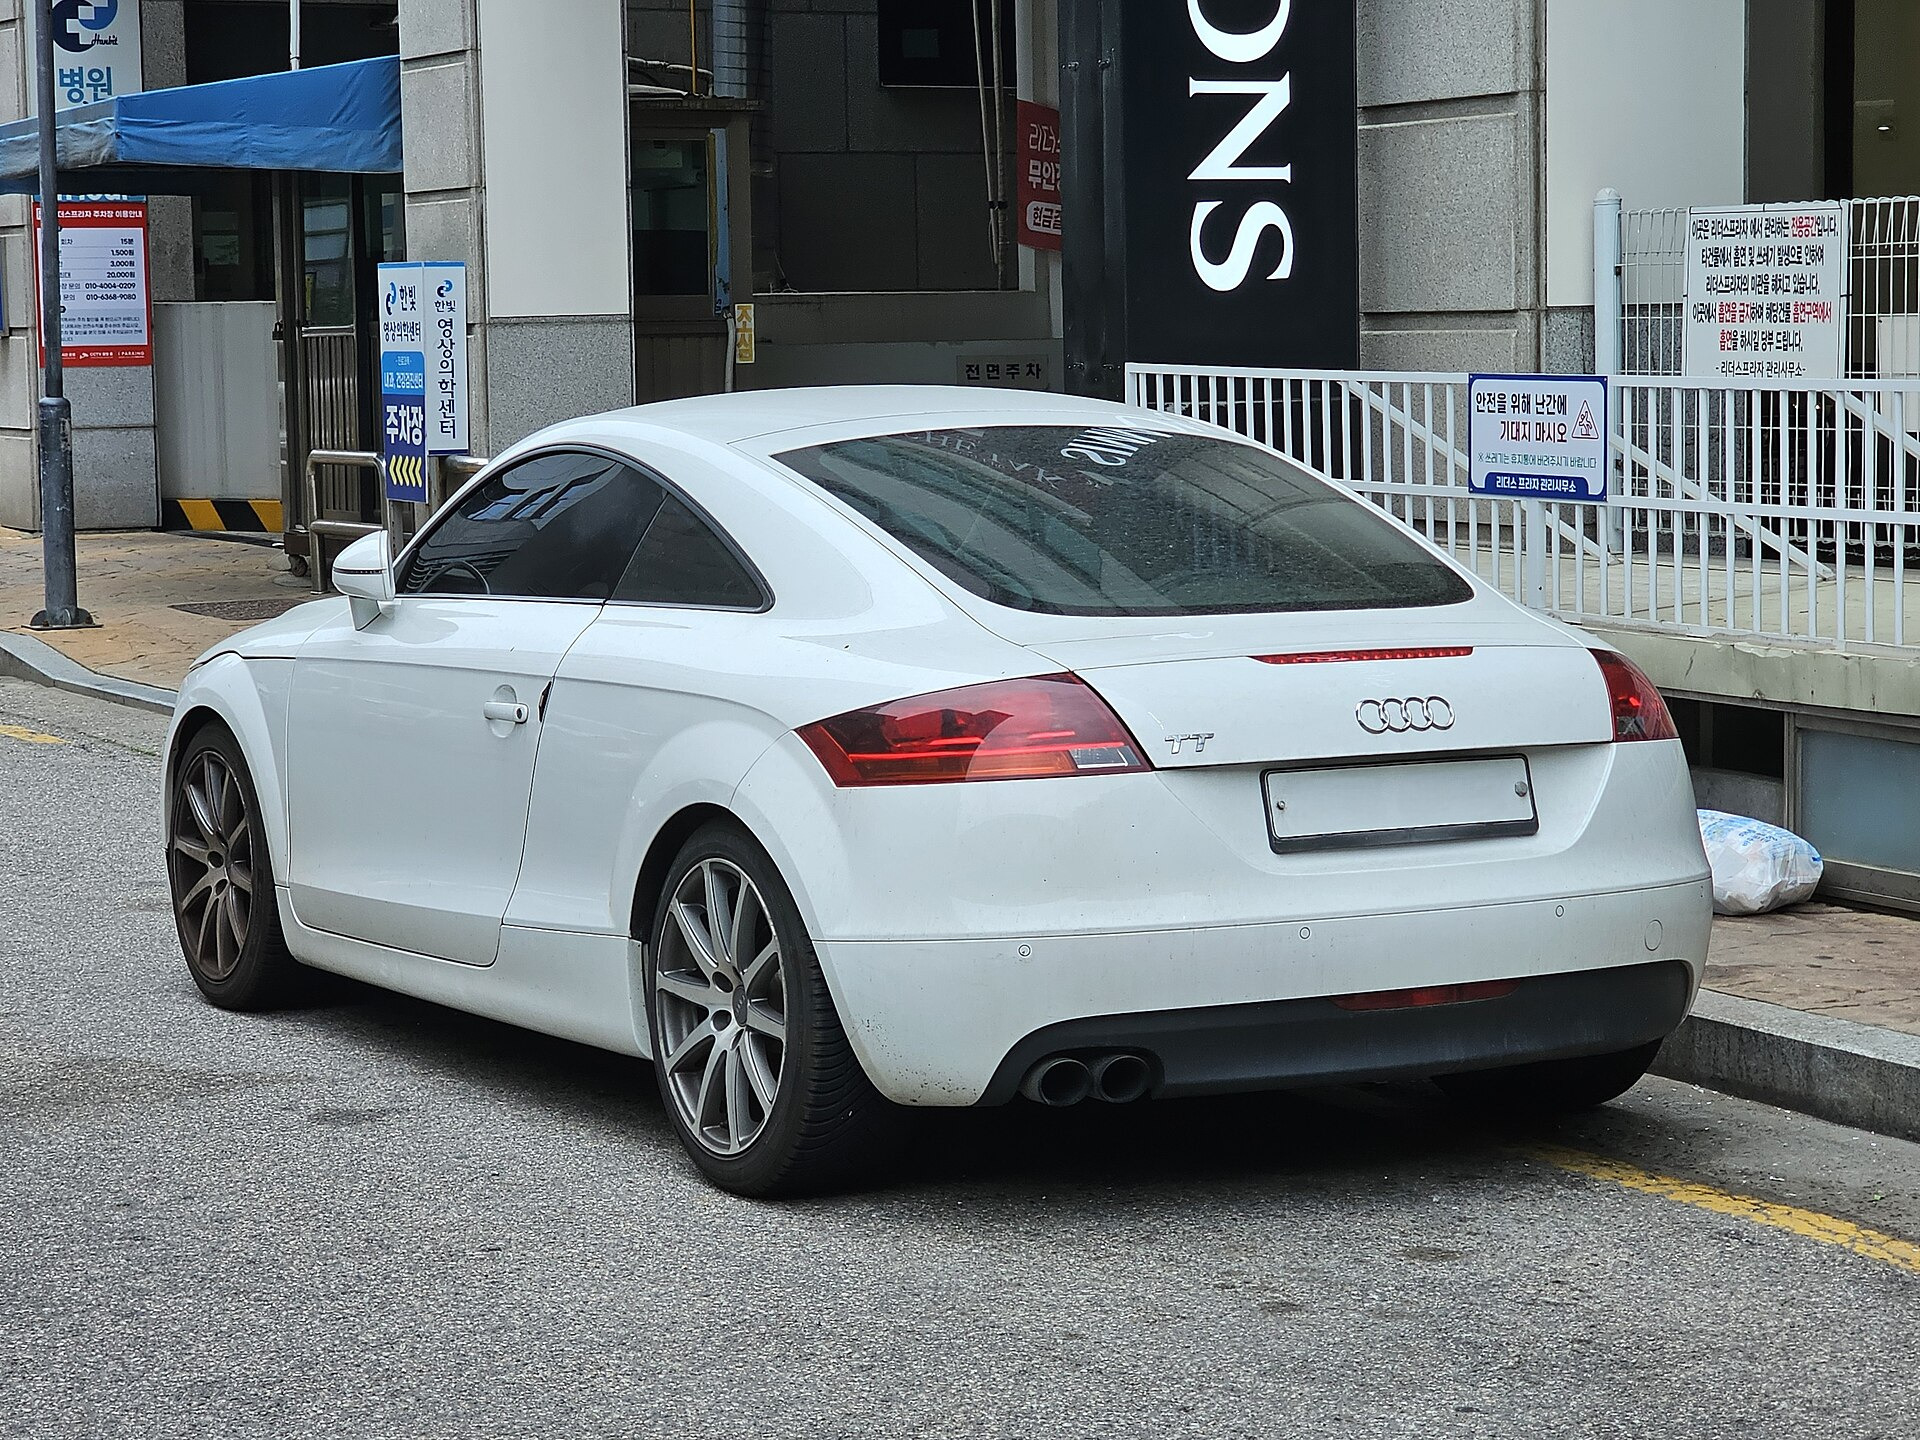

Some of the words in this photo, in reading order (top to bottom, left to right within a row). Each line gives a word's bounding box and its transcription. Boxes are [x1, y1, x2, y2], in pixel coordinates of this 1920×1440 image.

[91, 33, 118, 45] Hanbit
[59, 66, 112, 102] 병원
[1029, 123, 1060, 153] 리더
[1028, 159, 1060, 190] 무인
[93, 210, 113, 218] 주차장
[115, 210, 142, 218] 이용안내
[1692, 219, 1709, 240] 이곳은
[1711, 218, 1748, 240] 리더스프라자
[1750, 217, 1762, 239] 에서
[1765, 216, 1789, 238] 관리하는
[1791, 215, 1838, 238] 전용공간입니다.
[1701, 246, 1731, 267] 타건물에서
[1734, 246, 1746, 267] 흡연
[1748, 246, 1754, 267] 및
[1756, 245, 1775, 267] 쓰레기
[1777, 245, 1802, 267] 발생으로
[1805, 244, 1824, 266] 인하여
[1706, 274, 1749, 295] 리더스프라자의
[1751, 273, 1769, 294] 미관을
[1771, 273, 1790, 294] 해치고
[1793, 273, 1820, 295] 있습니다.
[399, 285, 416, 311] 한빛
[434, 300, 456, 313] 한빛
[1693, 302, 1716, 323] 이곳에서
[1718, 302, 1737, 323] 흡연을
[1738, 302, 1763, 323] 금지하여
[1765, 301, 1791, 323] 해당건물
[1793, 301, 1831, 323] 흡연구역에서
[383, 321, 421, 342] 영상의학센터
[1720, 330, 1738, 351] 흡연을
[1740, 330, 1760, 351] 하시길
[1761, 330, 1773, 351] 당부
[1776, 330, 1803, 351] 드립니다.
[437, 318, 456, 439] 영상의학센터
[1721, 360, 1764, 377] 리더스프라자
[1476, 392, 1506, 414] 안전을
[1511, 393, 1531, 414] 위해
[1535, 393, 1567, 415] 난간에
[386, 405, 423, 445] 주차장
[1500, 420, 1531, 442] 기대지
[1535, 422, 1567, 443] 마시오
[1485, 452, 1509, 464] 쓰레기는
[1537, 455, 1569, 467] 버려주시기
[1496, 476, 1517, 489] 리더스
[1518, 477, 1539, 490] 프라자
[1540, 478, 1576, 493] 관리사무소
[1165, 732, 1214, 754] TT
